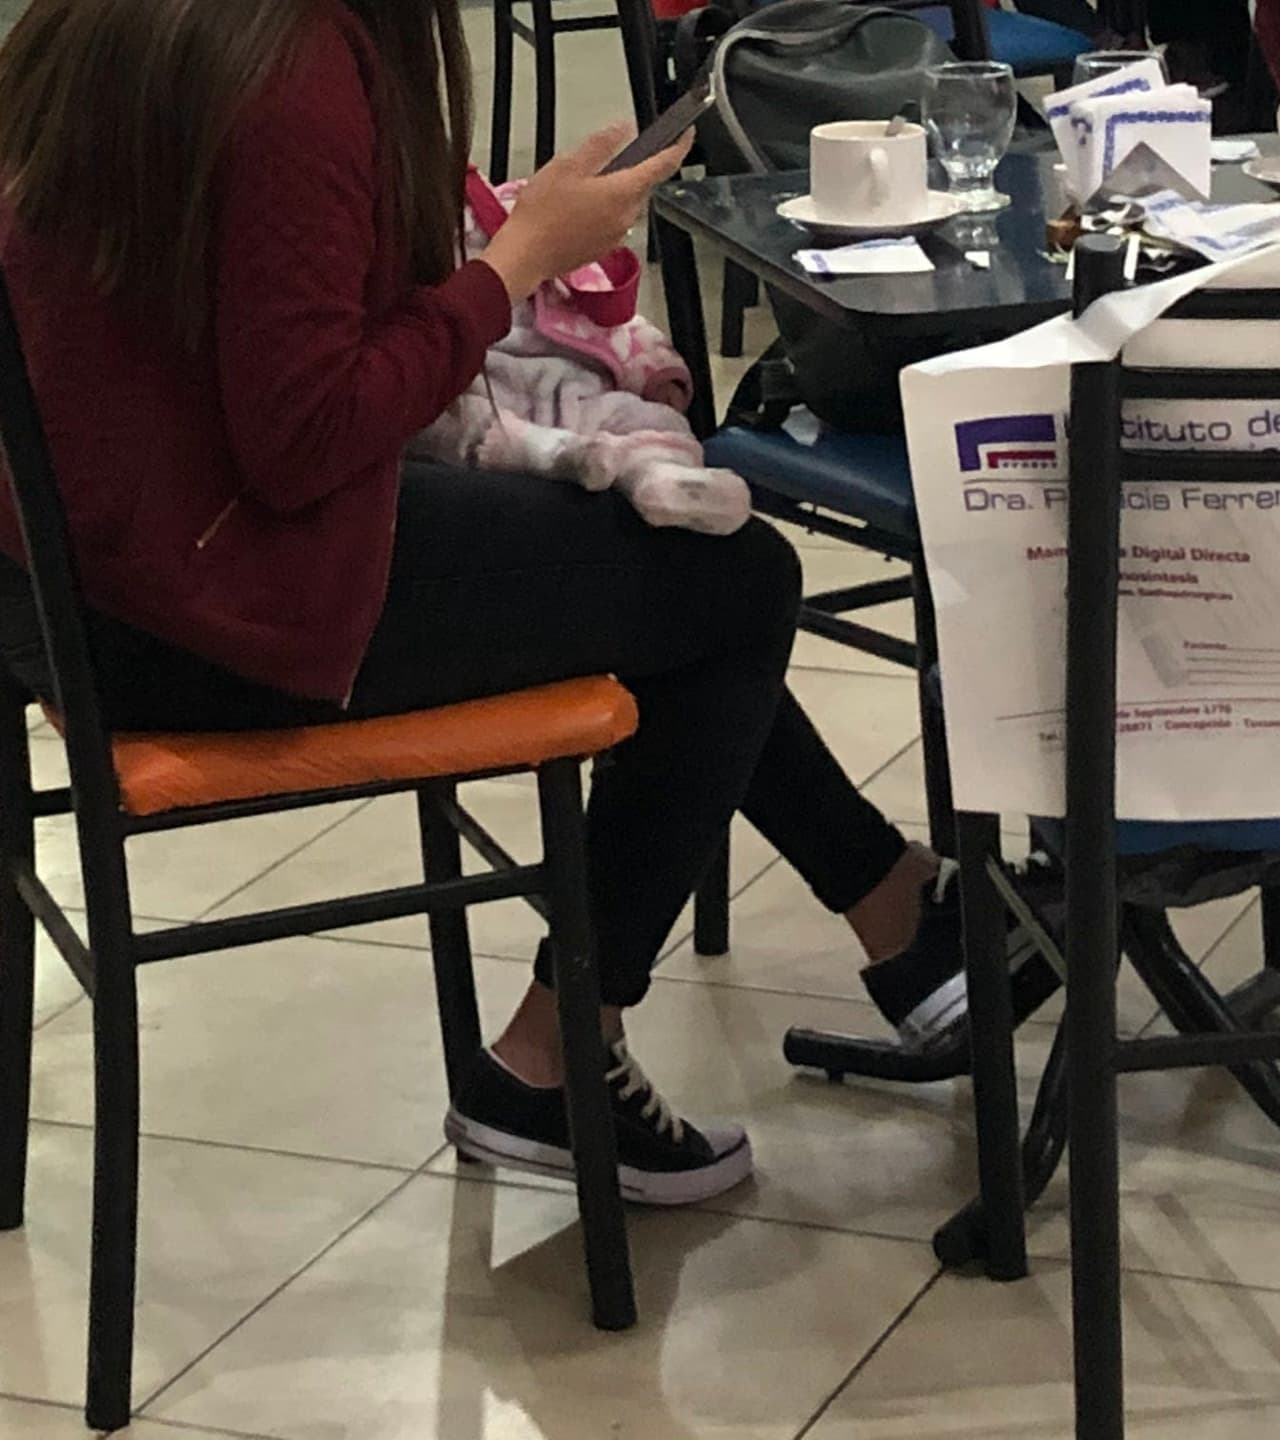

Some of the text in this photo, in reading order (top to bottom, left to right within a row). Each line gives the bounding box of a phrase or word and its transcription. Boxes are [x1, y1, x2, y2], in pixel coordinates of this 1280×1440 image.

[964, 488, 1035, 511] Dra.
[1132, 545, 1185, 563] Digital
[1191, 547, 1251, 562] Directa
